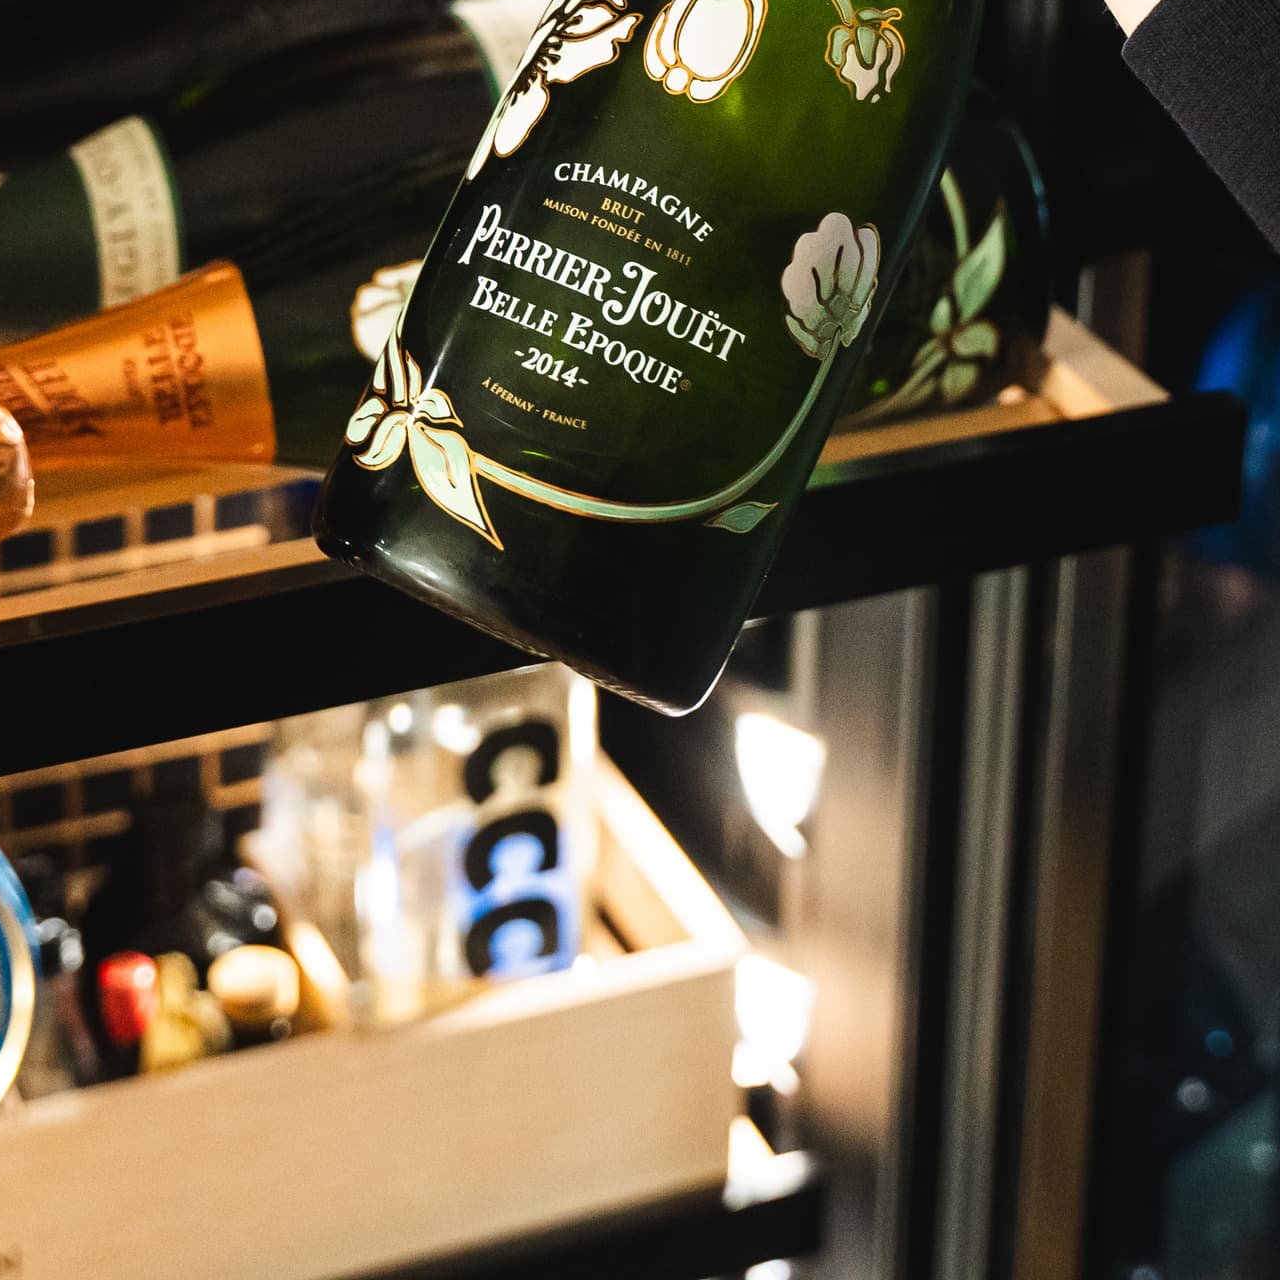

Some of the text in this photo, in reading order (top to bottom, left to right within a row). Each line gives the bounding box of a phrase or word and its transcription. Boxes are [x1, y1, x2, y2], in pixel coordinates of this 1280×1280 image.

[542, 197, 693, 267] MAISON FONDÉE EN 1811
[553, 162, 714, 243] CHAMPAGNE
[600, 196, 646, 225] BRUT
[469, 275, 684, 395] BELLE EPOQUE
[489, 382, 535, 412] ÉPERNAY
[542, 408, 588, 431] FRANCE
